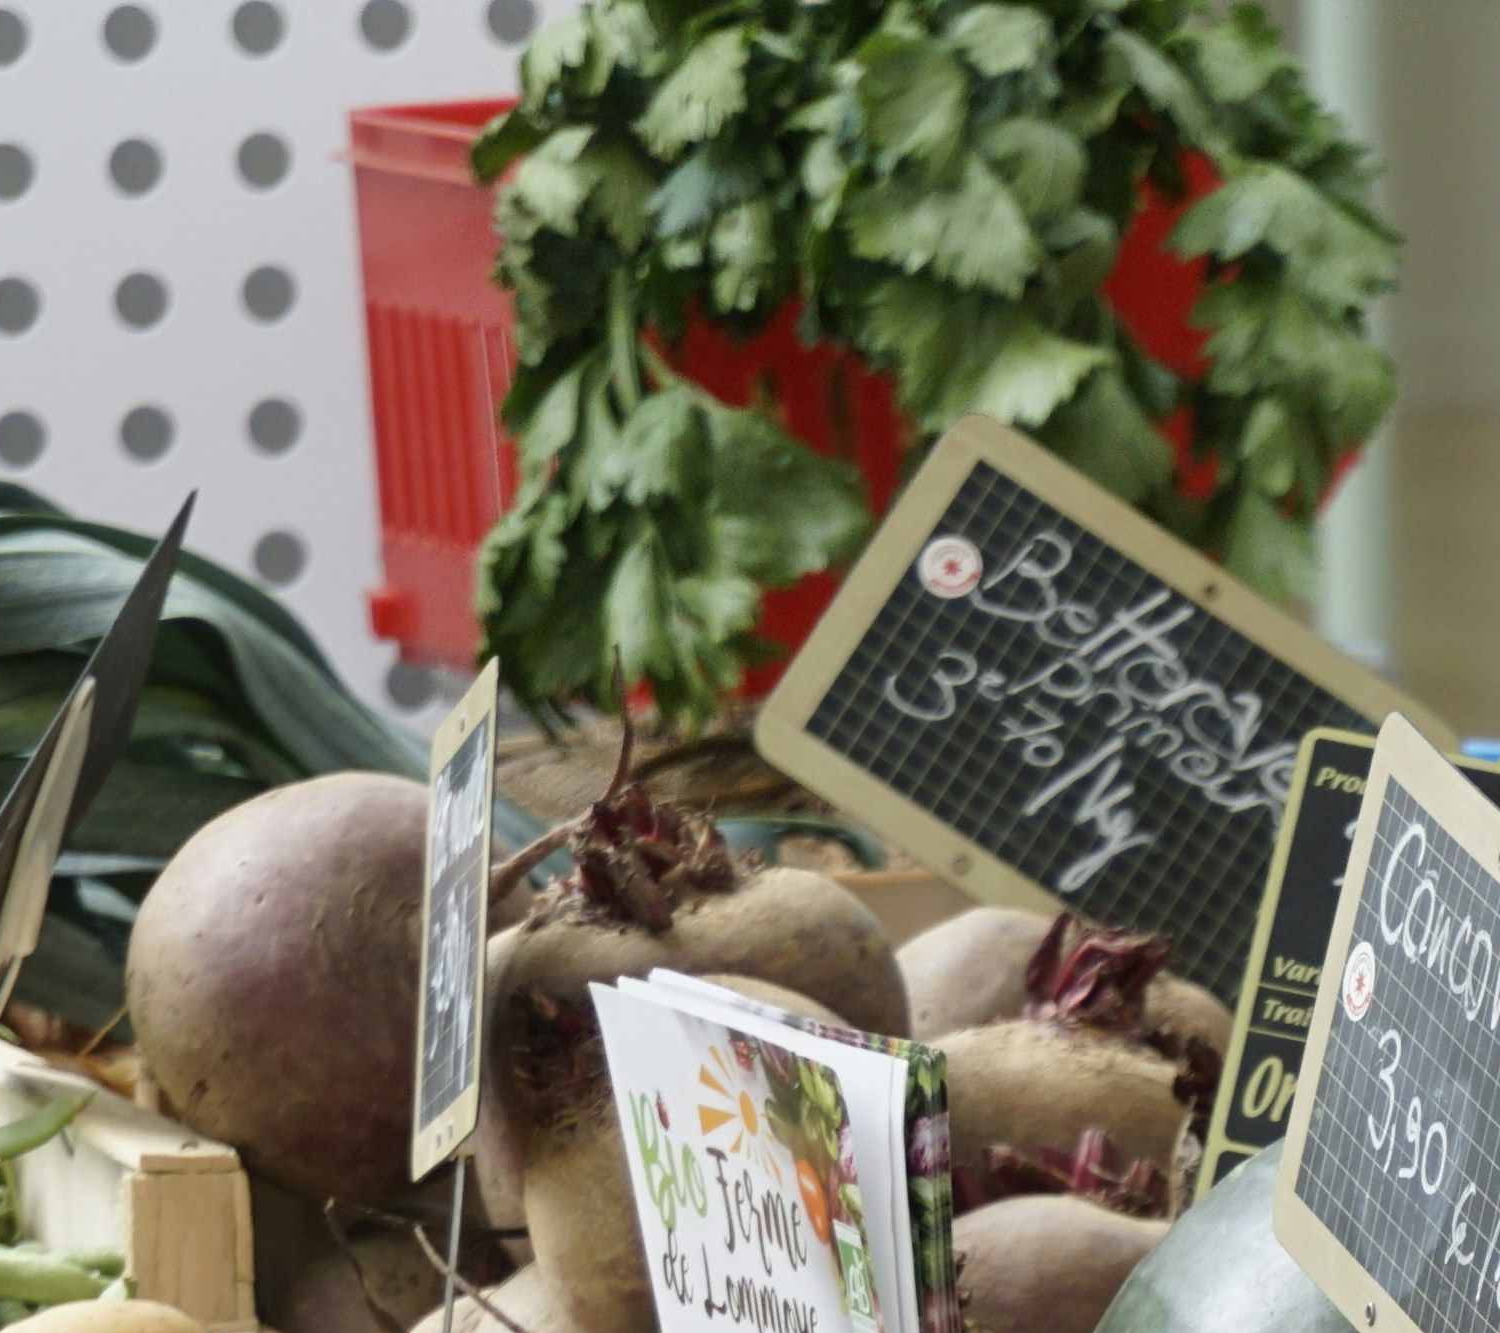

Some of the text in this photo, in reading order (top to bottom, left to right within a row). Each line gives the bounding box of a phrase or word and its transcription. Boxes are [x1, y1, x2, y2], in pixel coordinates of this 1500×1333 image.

[628, 1089, 808, 1277] Bio Ferme
[1367, 1028, 1448, 1195] 3,90
[662, 1227, 694, 1306] de
